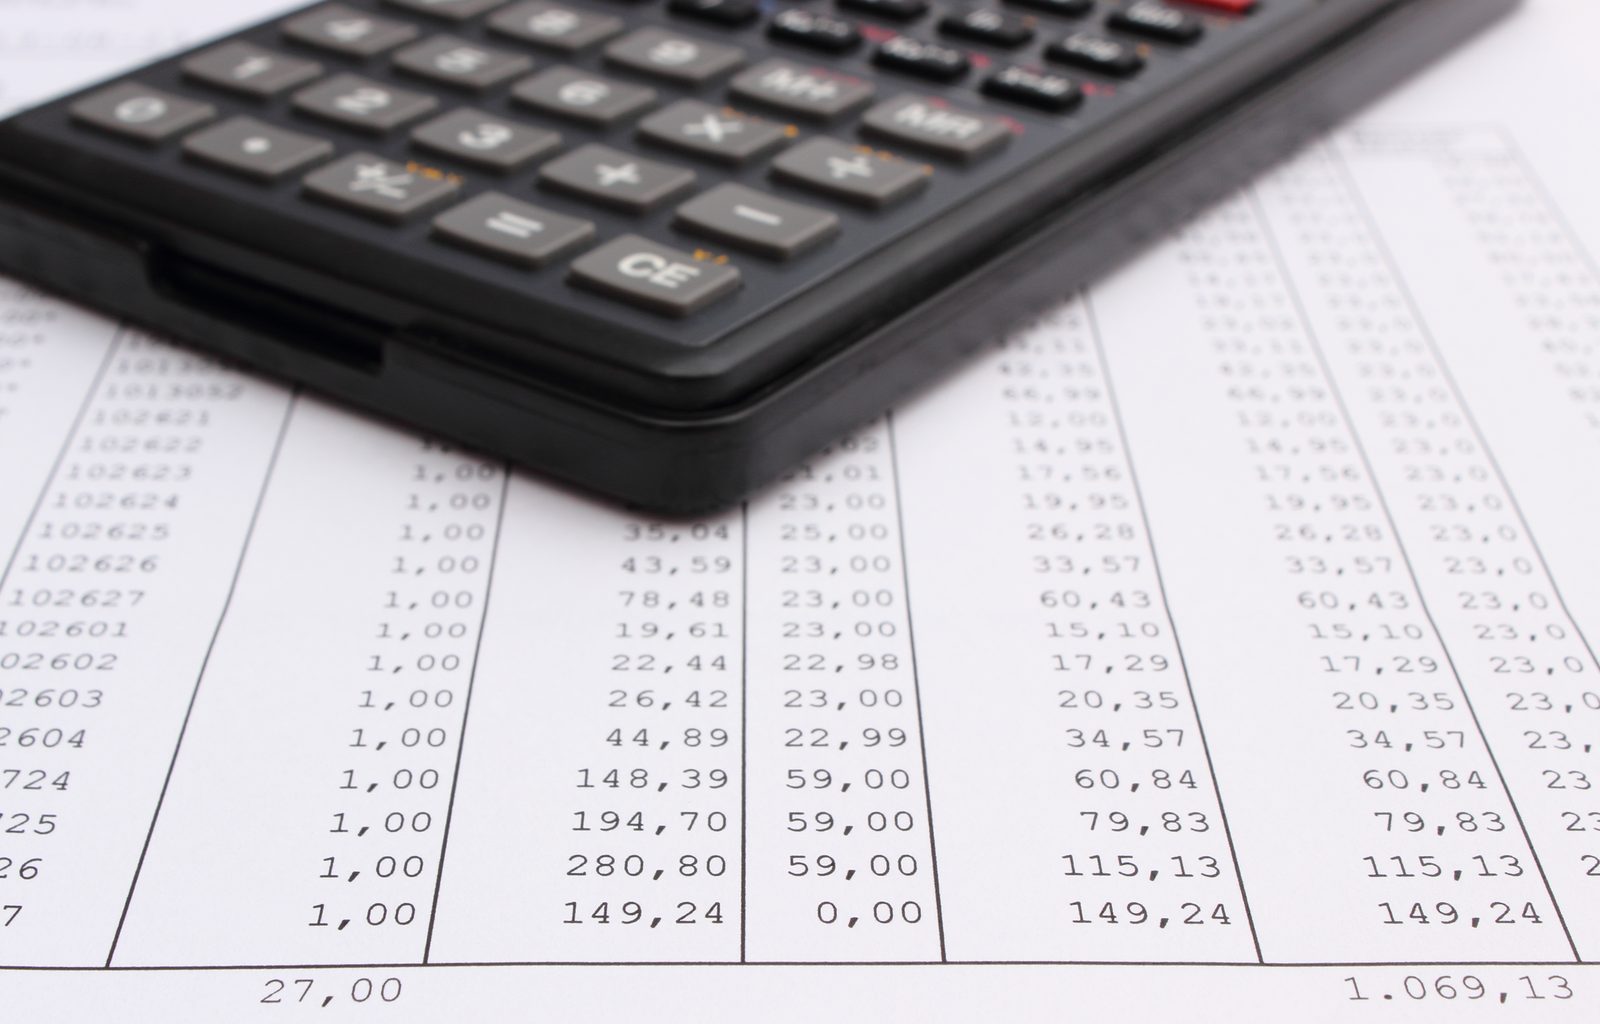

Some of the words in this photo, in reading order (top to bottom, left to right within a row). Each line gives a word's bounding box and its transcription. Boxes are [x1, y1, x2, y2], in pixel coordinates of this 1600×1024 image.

[458, 123, 512, 149] 3
[617, 251, 701, 288] CE
[782, 463, 880, 483] 1,01
[1018, 463, 1123, 484] 17,56
[1255, 463, 1361, 484] 17,56
[1403, 463, 1490, 485] 23,0
[54, 492, 180, 511] 102624
[407, 491, 493, 513] 1,00
[779, 492, 887, 512] 23,00
[1023, 492, 1130, 513] 19,95
[1265, 493, 1373, 514] 19,95
[1417, 493, 1504, 515] 23,0
[38, 521, 170, 541] 102625
[399, 522, 486, 544] 1,00
[780, 522, 889, 544] 25,00
[1026, 522, 1136, 543] 26,28
[1274, 523, 1384, 545] 26,28
[1429, 523, 1518, 545] 23,0
[23, 553, 158, 574] 102626
[391, 555, 480, 577] 1,00
[620, 555, 732, 577] 43,59
[780, 554, 892, 577] 23,00
[1033, 554, 1141, 577] 33,57
[1285, 555, 1393, 577] 33,57
[1442, 555, 1534, 578] 23,0
[8, 588, 146, 608] 102627
[384, 590, 474, 612] 1,00
[618, 590, 730, 611] 78,48
[781, 588, 894, 611] 23,00
[1039, 589, 1152, 611] 60,43
[1296, 590, 1410, 613] 60,43
[1457, 590, 1549, 613] 23,0
[375, 622, 468, 642] 1,00
[616, 621, 729, 641] 19,61
[782, 620, 897, 641] 23,00
[1045, 621, 1161, 641] 15,10
[1308, 622, 1424, 643] 15,10
[1472, 623, 1567, 643] 23,0
[367, 653, 461, 675] 1,00
[610, 653, 727, 675] 22,44
[782, 652, 899, 674] 22,98
[1051, 653, 1170, 675] 17,29
[1319, 655, 1439, 677] 17,29
[1488, 655, 1585, 677] 23,0
[0, 687, 104, 709] 2603
[357, 689, 454, 712] 1,00
[607, 689, 728, 712] 26,42
[783, 688, 903, 712] 23,00
[1057, 689, 1180, 713] 20,35
[1332, 691, 1455, 714] 20,35
[348, 727, 447, 752] 1,00
[605, 727, 729, 751] 44,89
[784, 727, 907, 751] 22,99
[1065, 728, 1184, 752] 34,57
[1346, 729, 1465, 753] 34,57
[1523, 730, 1592, 754] 23,
[2, 768, 71, 791] 724
[339, 768, 439, 794] 1,00
[576, 768, 728, 793] 148,39
[785, 768, 910, 793] 59,00
[1074, 768, 1198, 793] 60,84
[1362, 769, 1488, 794] 60,84
[1541, 769, 1592, 791] 23
[0, 812, 57, 835] 25
[329, 811, 432, 838] 1,00
[572, 810, 727, 836] 194,70
[787, 810, 914, 836] 59,00
[1079, 811, 1210, 837] 79,83
[1373, 811, 1506, 837] 79,83
[319, 855, 424, 883] 1,00
[566, 854, 726, 881] 280,80
[787, 854, 918, 881] 59,00
[1061, 854, 1221, 882] 115,13
[1362, 854, 1524, 882] 115,13
[2, 904, 23, 927] 7
[308, 902, 416, 931] 1,00
[563, 901, 724, 929] 149,24
[817, 900, 922, 929] 0,00
[1069, 901, 1232, 929] 149,24
[1377, 901, 1543, 929] 149,24
[259, 977, 402, 1008] 27,00
[1344, 974, 1574, 1005] 1.069,13
